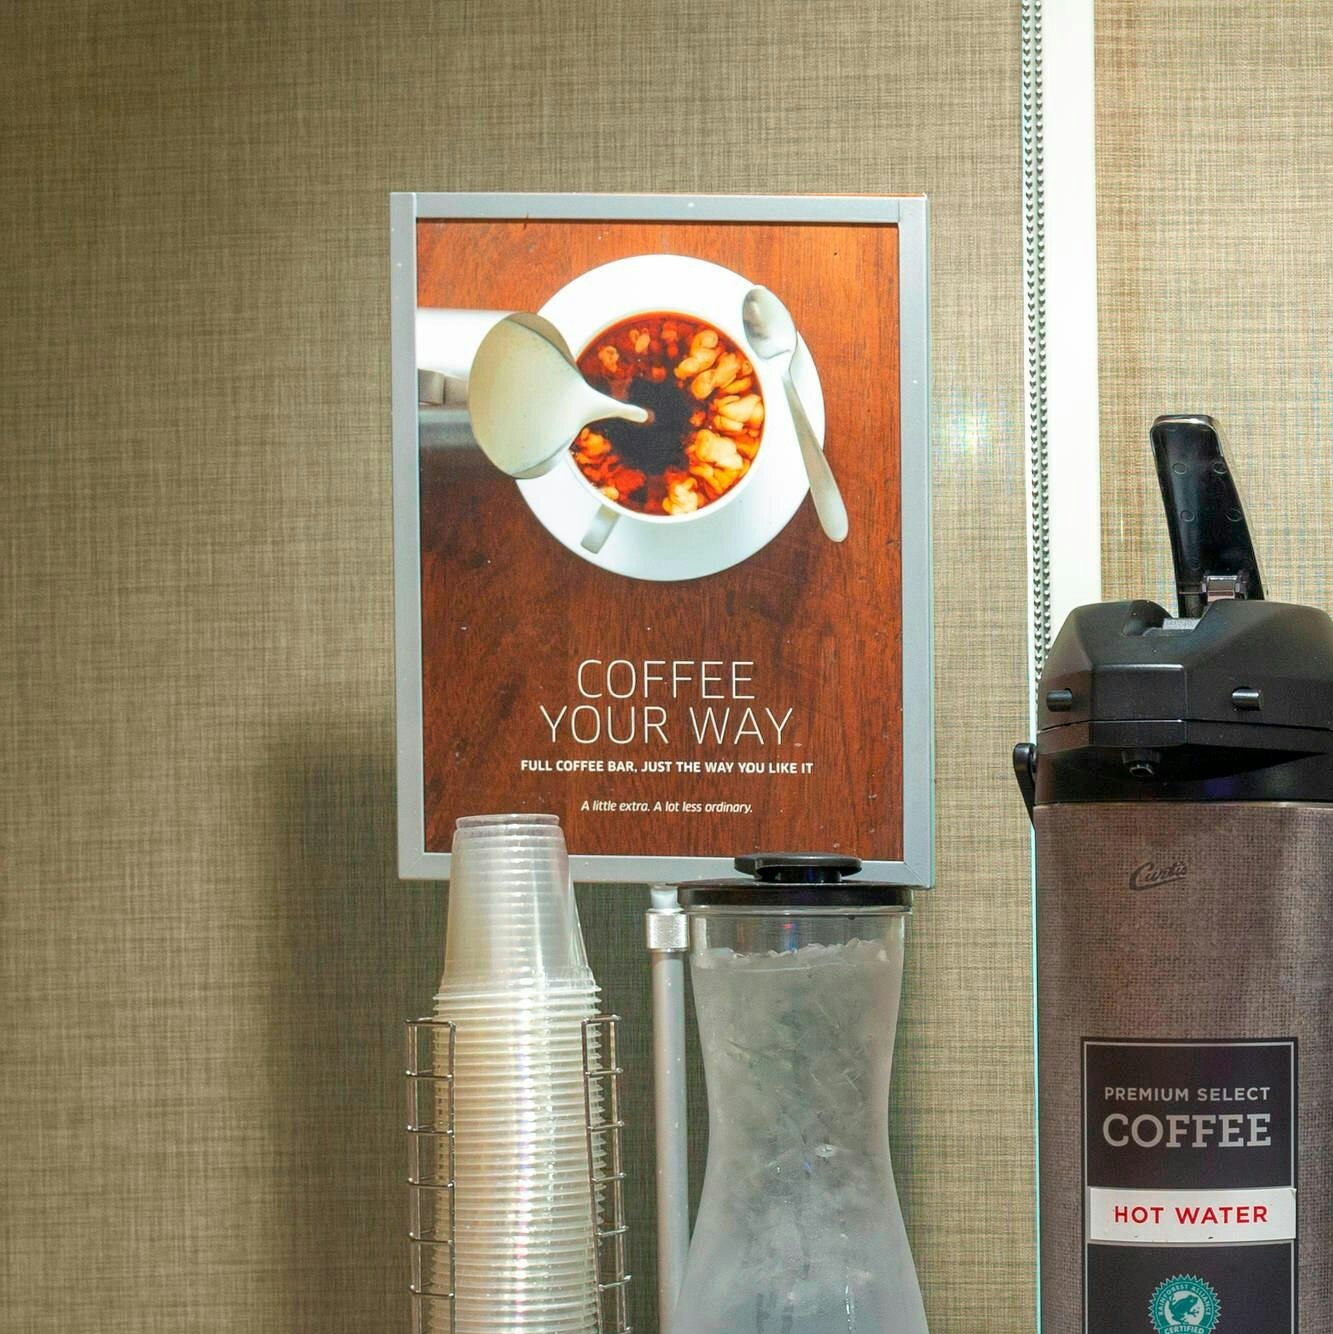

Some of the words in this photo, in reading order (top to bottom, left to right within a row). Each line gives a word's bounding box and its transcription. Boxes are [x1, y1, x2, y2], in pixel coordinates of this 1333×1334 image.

[577, 659, 756, 700] COFFEE
[540, 704, 669, 744] YOUR
[689, 706, 794, 745] WAY
[520, 759, 553, 772] FULL
[555, 760, 604, 772] COFFEE
[607, 760, 638, 773] BAR,
[640, 761, 673, 773] JUST
[676, 761, 702, 773] THE
[704, 762, 735, 773] WAY
[738, 762, 766, 774] YOU
[768, 762, 798, 774] LIKE
[801, 762, 814, 774] IT
[580, 800, 591, 812] A
[592, 799, 617, 812] little
[618, 801, 651, 813] extra.
[653, 801, 662, 812] A
[664, 801, 680, 813] lot
[682, 801, 702, 813] less
[704, 801, 753, 815] ordinary.
[1129, 861, 1187, 891] Curtis
[1104, 1086, 1190, 1102] PREMIUM
[1197, 1086, 1271, 1101] SELECT
[1102, 1112, 1272, 1148] COFFEE
[1114, 1205, 1165, 1225] HOT
[1175, 1206, 1268, 1224] WATER
[1164, 1325, 1205, 1334] CERTIFIED
